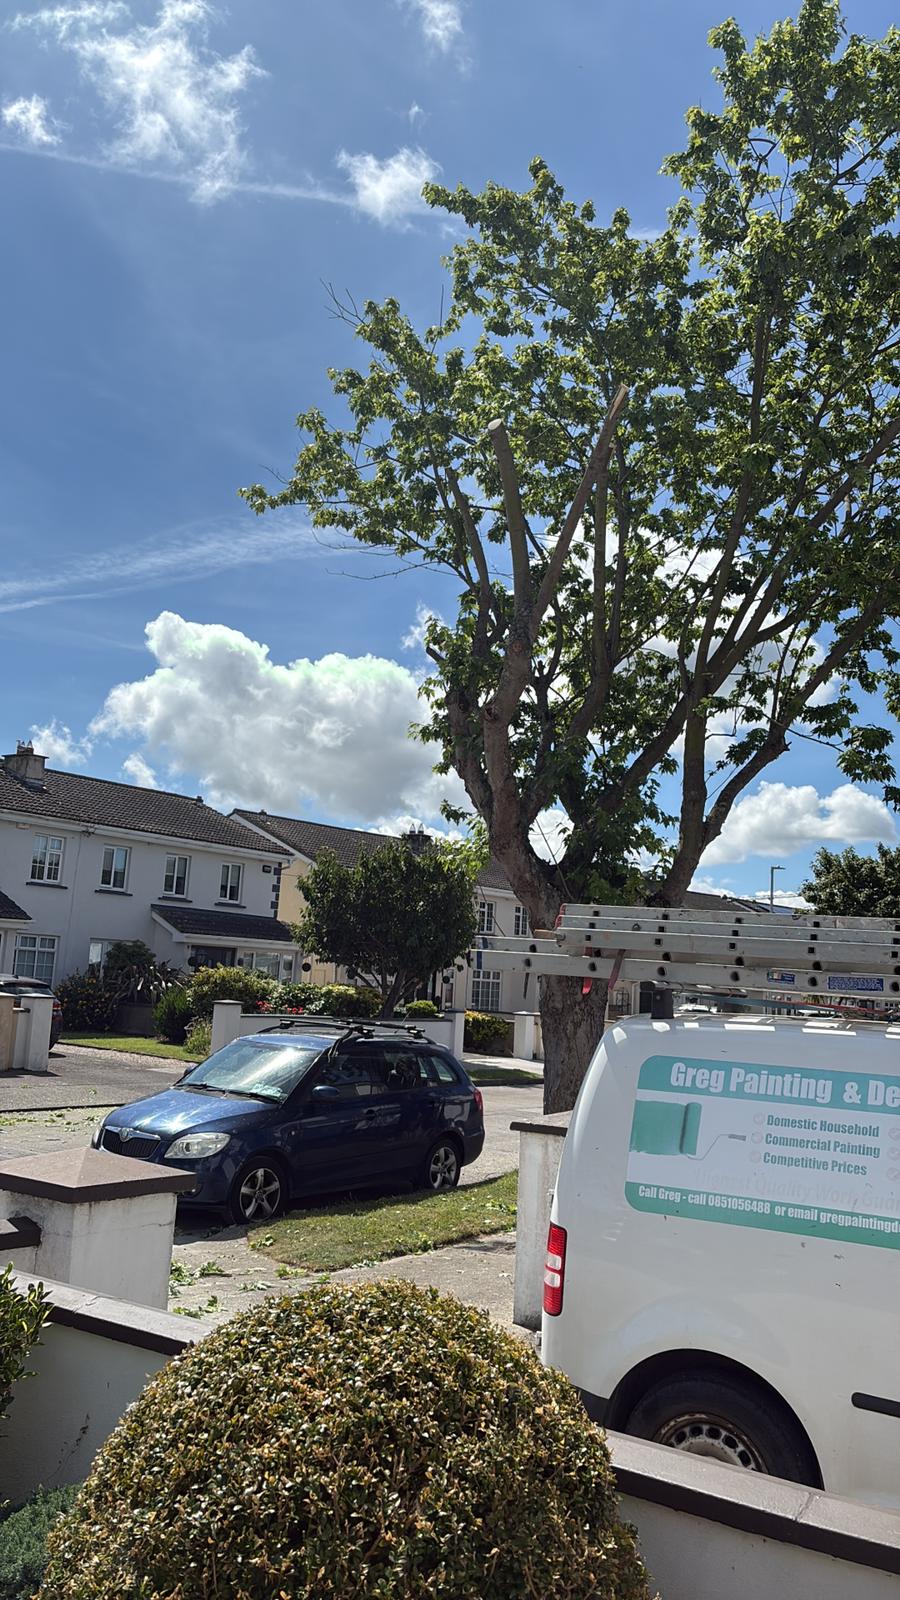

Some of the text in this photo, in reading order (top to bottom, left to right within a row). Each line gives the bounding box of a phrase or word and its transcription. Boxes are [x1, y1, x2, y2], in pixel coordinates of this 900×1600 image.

[670, 1062, 900, 1107] Greg Painting & De
[766, 1114, 880, 1138] Domestic Household
[765, 1133, 881, 1159] Commercial Painting
[763, 1152, 868, 1176] Competitive Prices
[638, 1185, 657, 1198] Call
[658, 1188, 681, 1203] Greg
[687, 1192, 706, 1206] call
[708, 1194, 771, 1214] 0851056488
[774, 1204, 787, 1217] or
[787, 1206, 818, 1221] email
